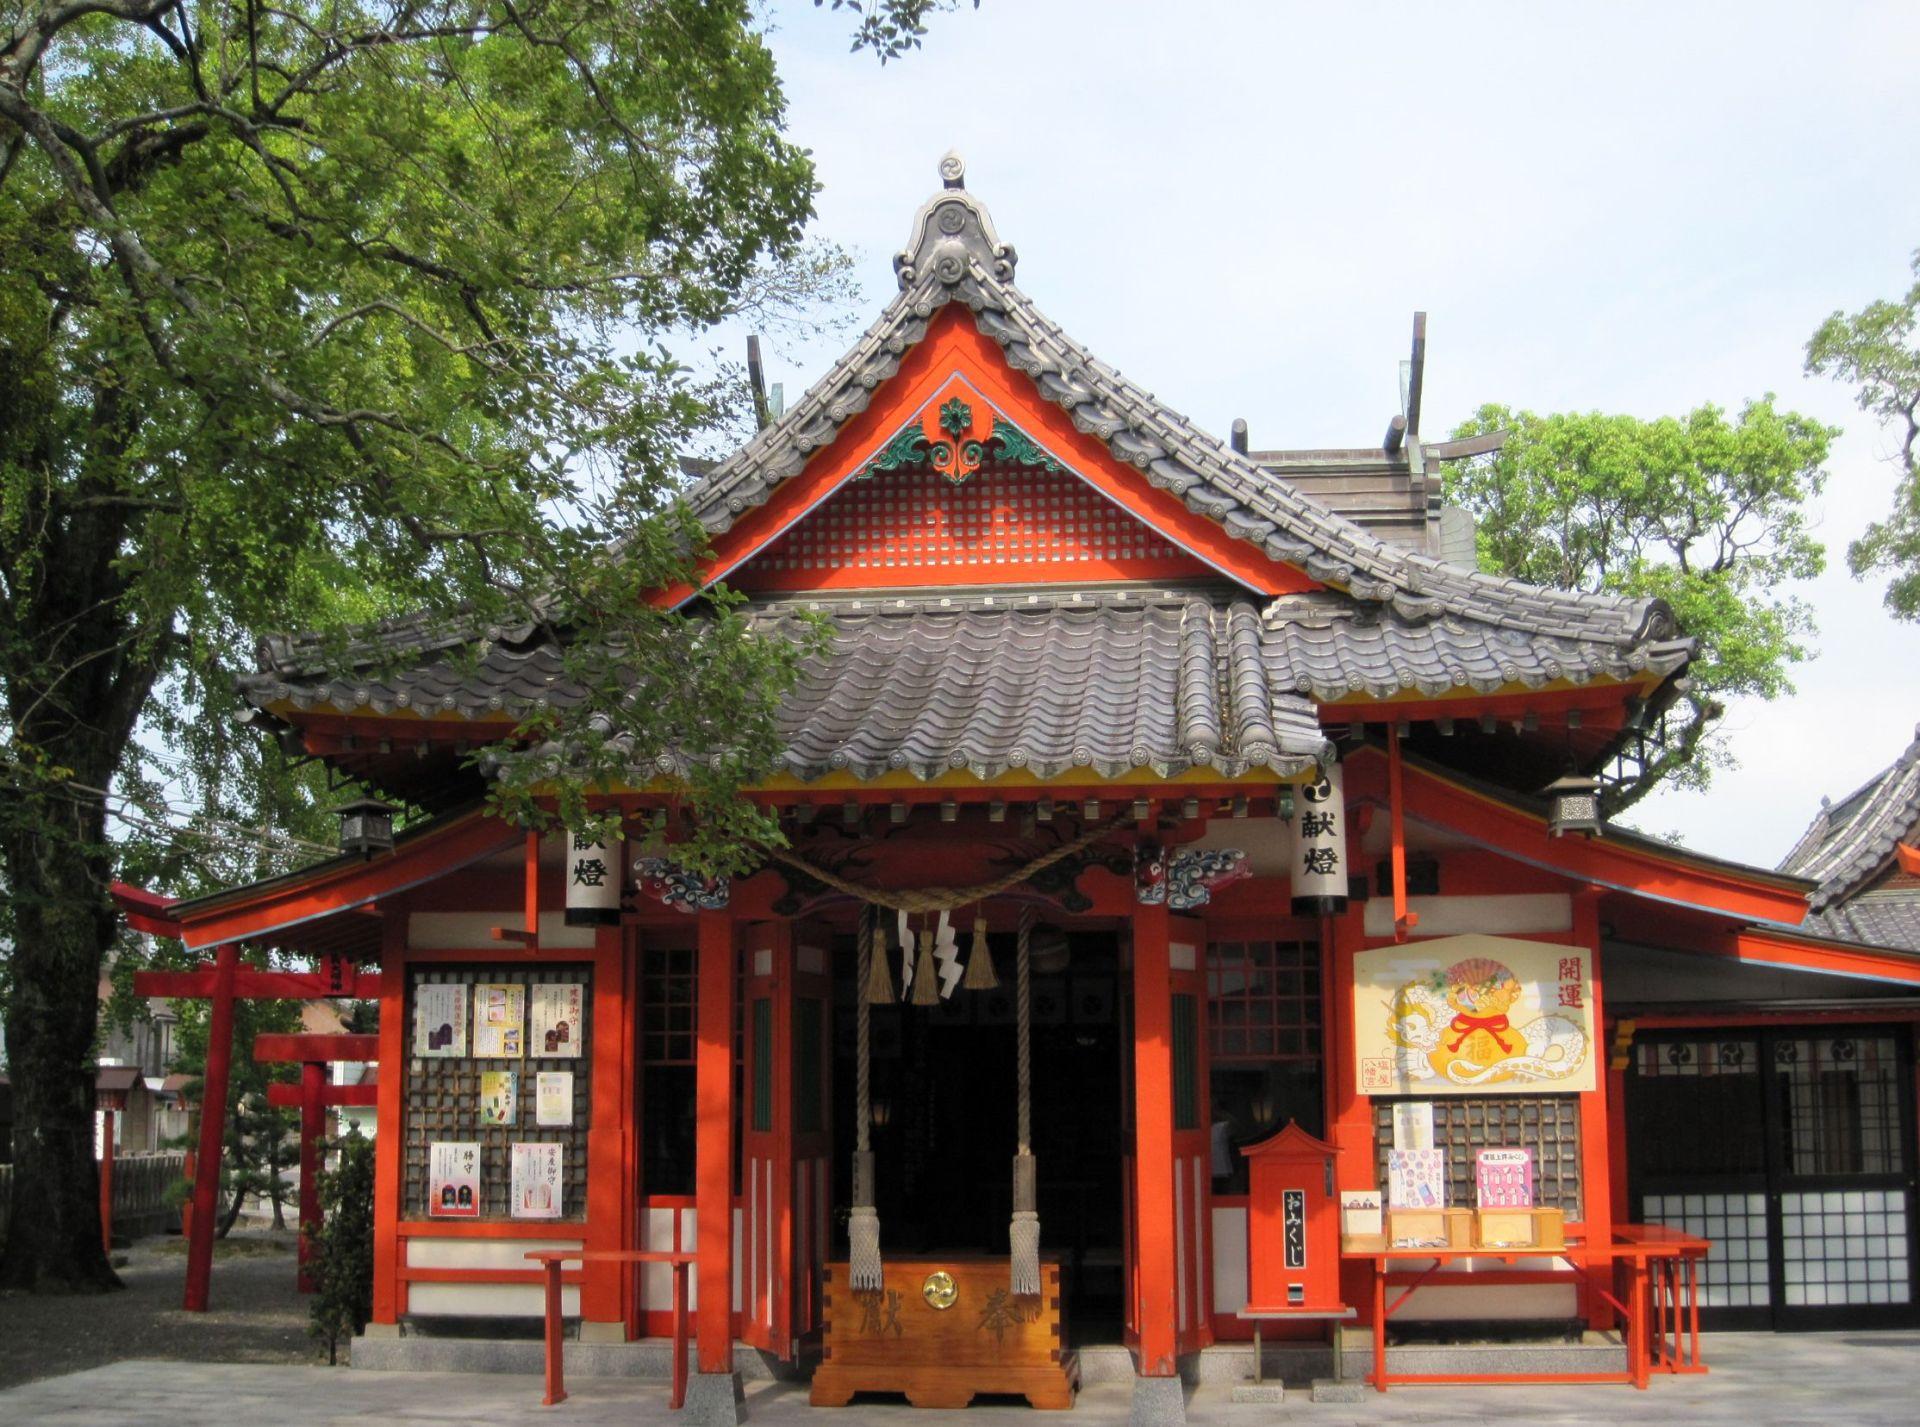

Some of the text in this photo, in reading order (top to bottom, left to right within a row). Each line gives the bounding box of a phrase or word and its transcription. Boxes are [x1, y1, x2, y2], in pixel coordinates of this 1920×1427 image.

[1302, 811, 1338, 875] 献燈
[1558, 956, 1584, 1009] 開運
[1464, 1034, 1492, 1062] 福
[463, 1150, 474, 1175] 勝守
[547, 1148, 557, 1186] 安産御守
[1286, 1193, 1302, 1266] おみくじ
